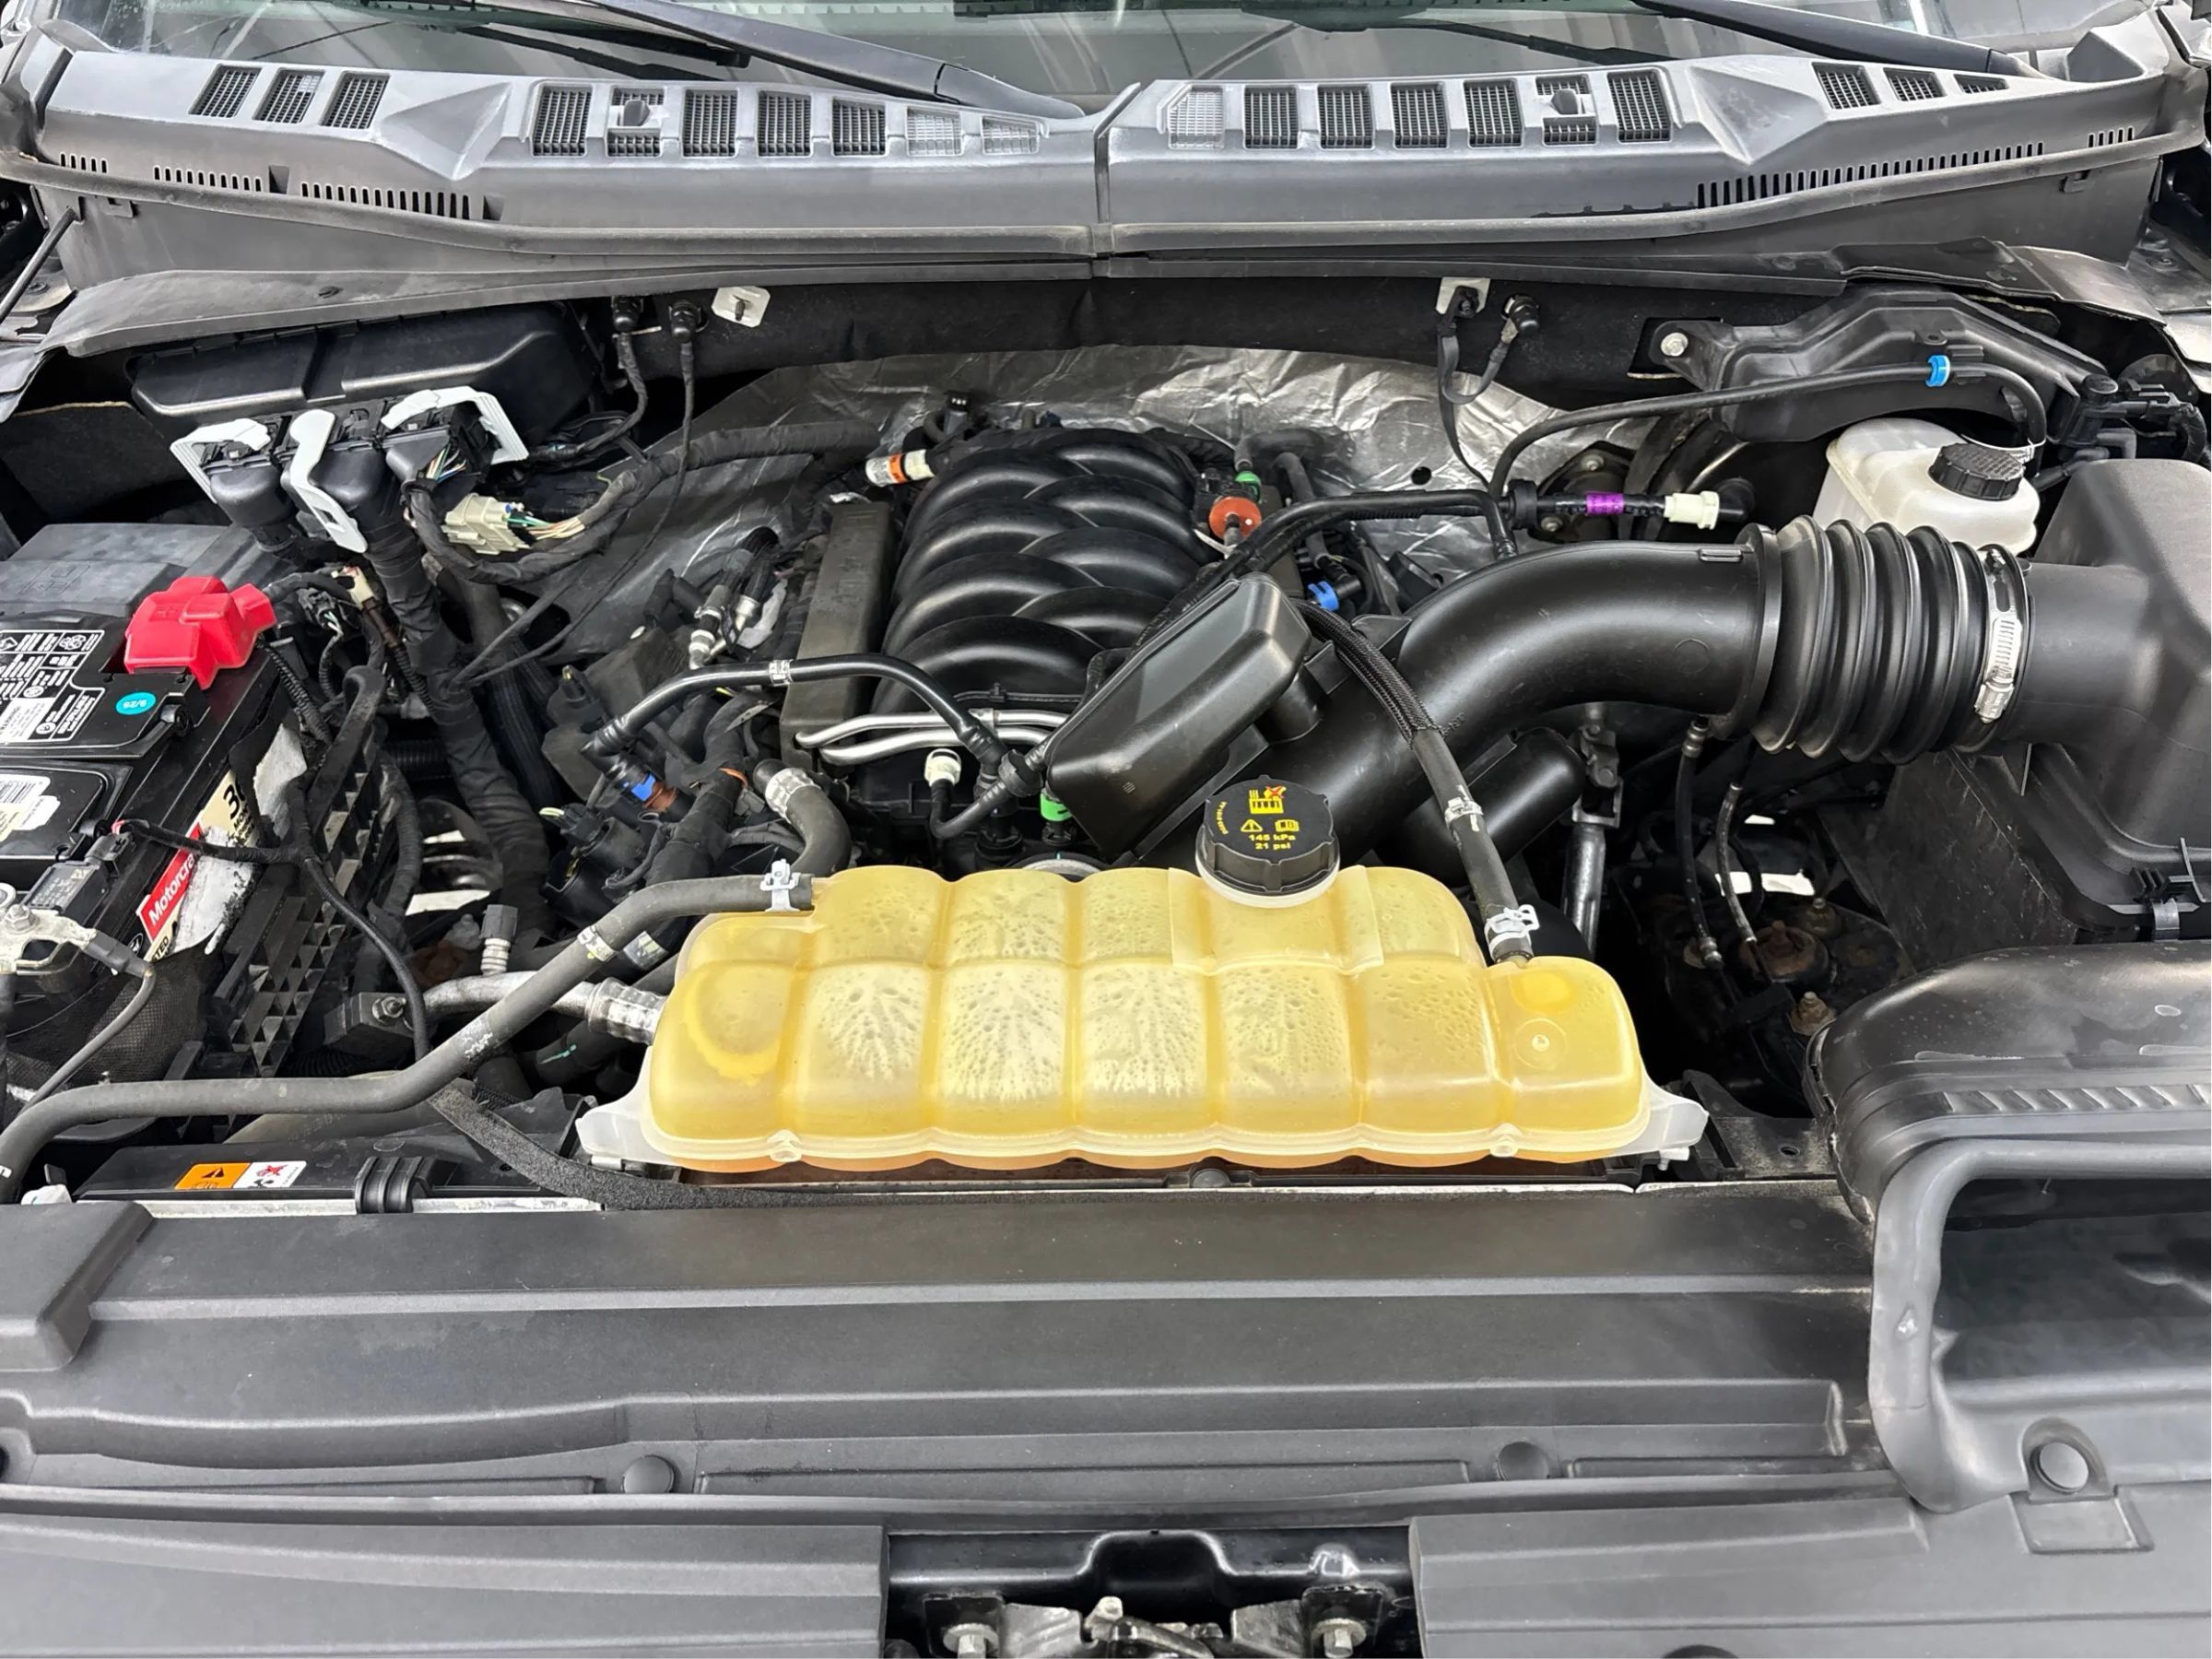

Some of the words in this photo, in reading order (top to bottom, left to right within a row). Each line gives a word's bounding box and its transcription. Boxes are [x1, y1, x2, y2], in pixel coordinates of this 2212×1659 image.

[1248, 833, 1270, 841] 145
[1273, 833, 1297, 841] kPa
[1273, 841, 1291, 851] psi
